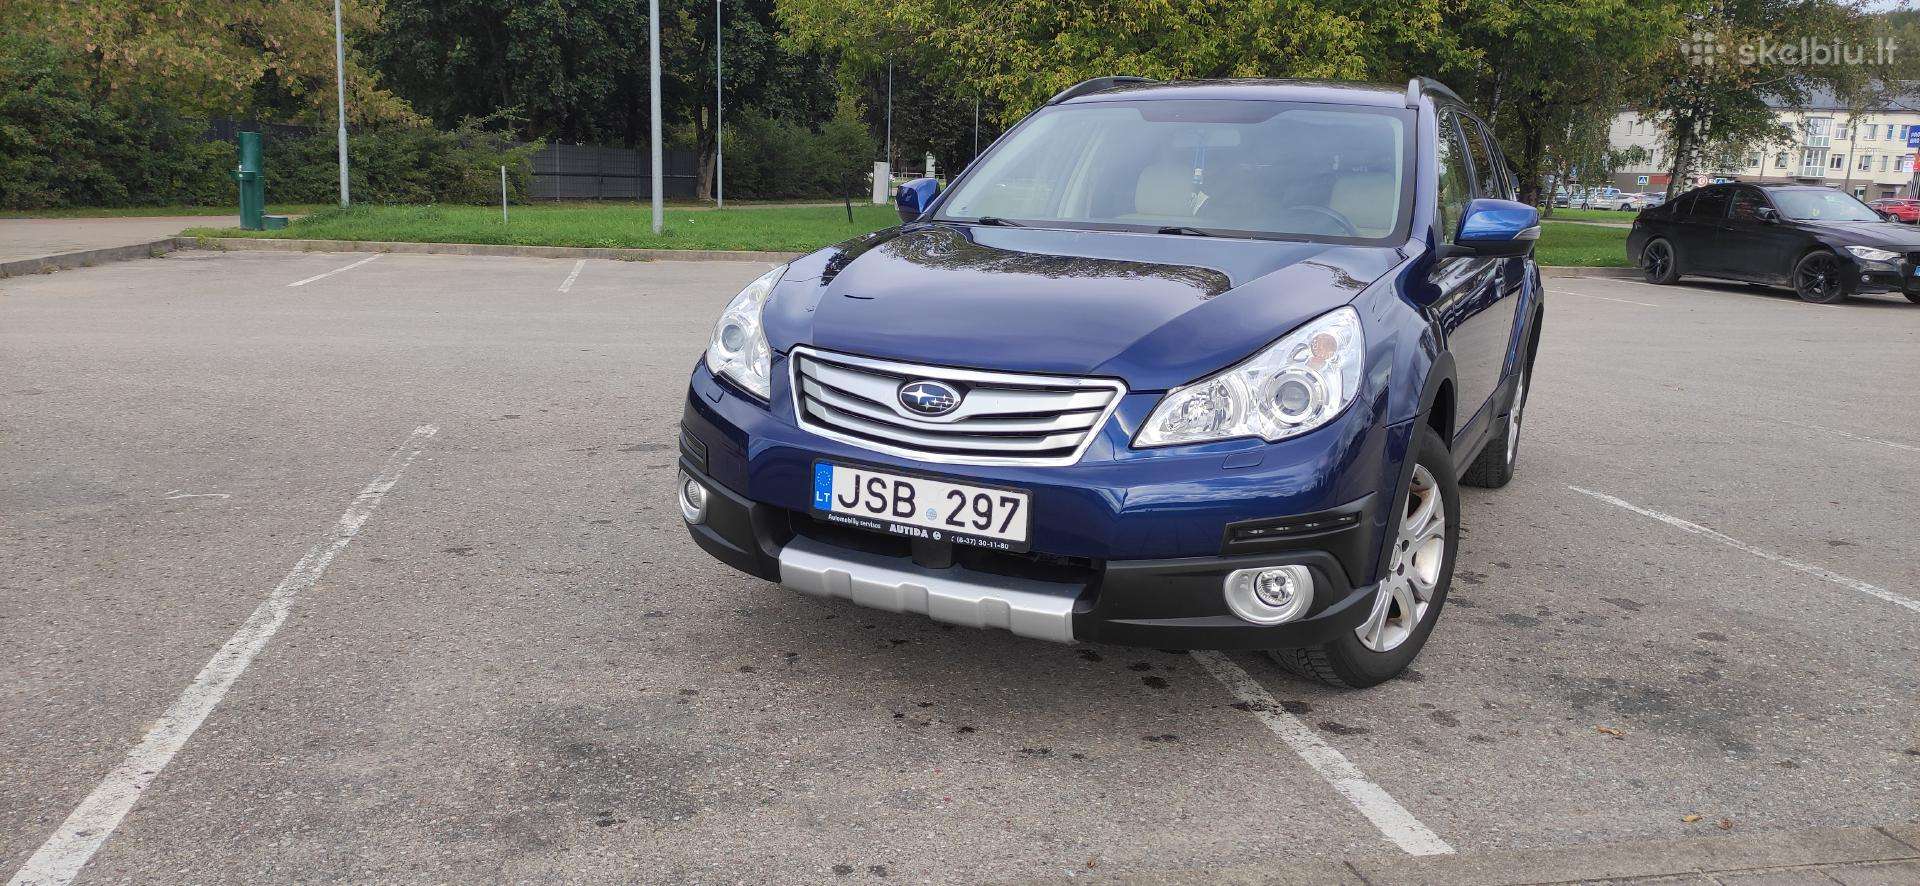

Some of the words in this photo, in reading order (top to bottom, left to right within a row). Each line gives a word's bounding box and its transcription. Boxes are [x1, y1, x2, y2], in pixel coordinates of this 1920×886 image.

[816, 491, 830, 502] LT
[837, 474, 916, 518] JSB
[945, 489, 1021, 533] 297
[889, 523, 929, 539] AUTIDA
[978, 539, 1009, 550] 30-11-80
